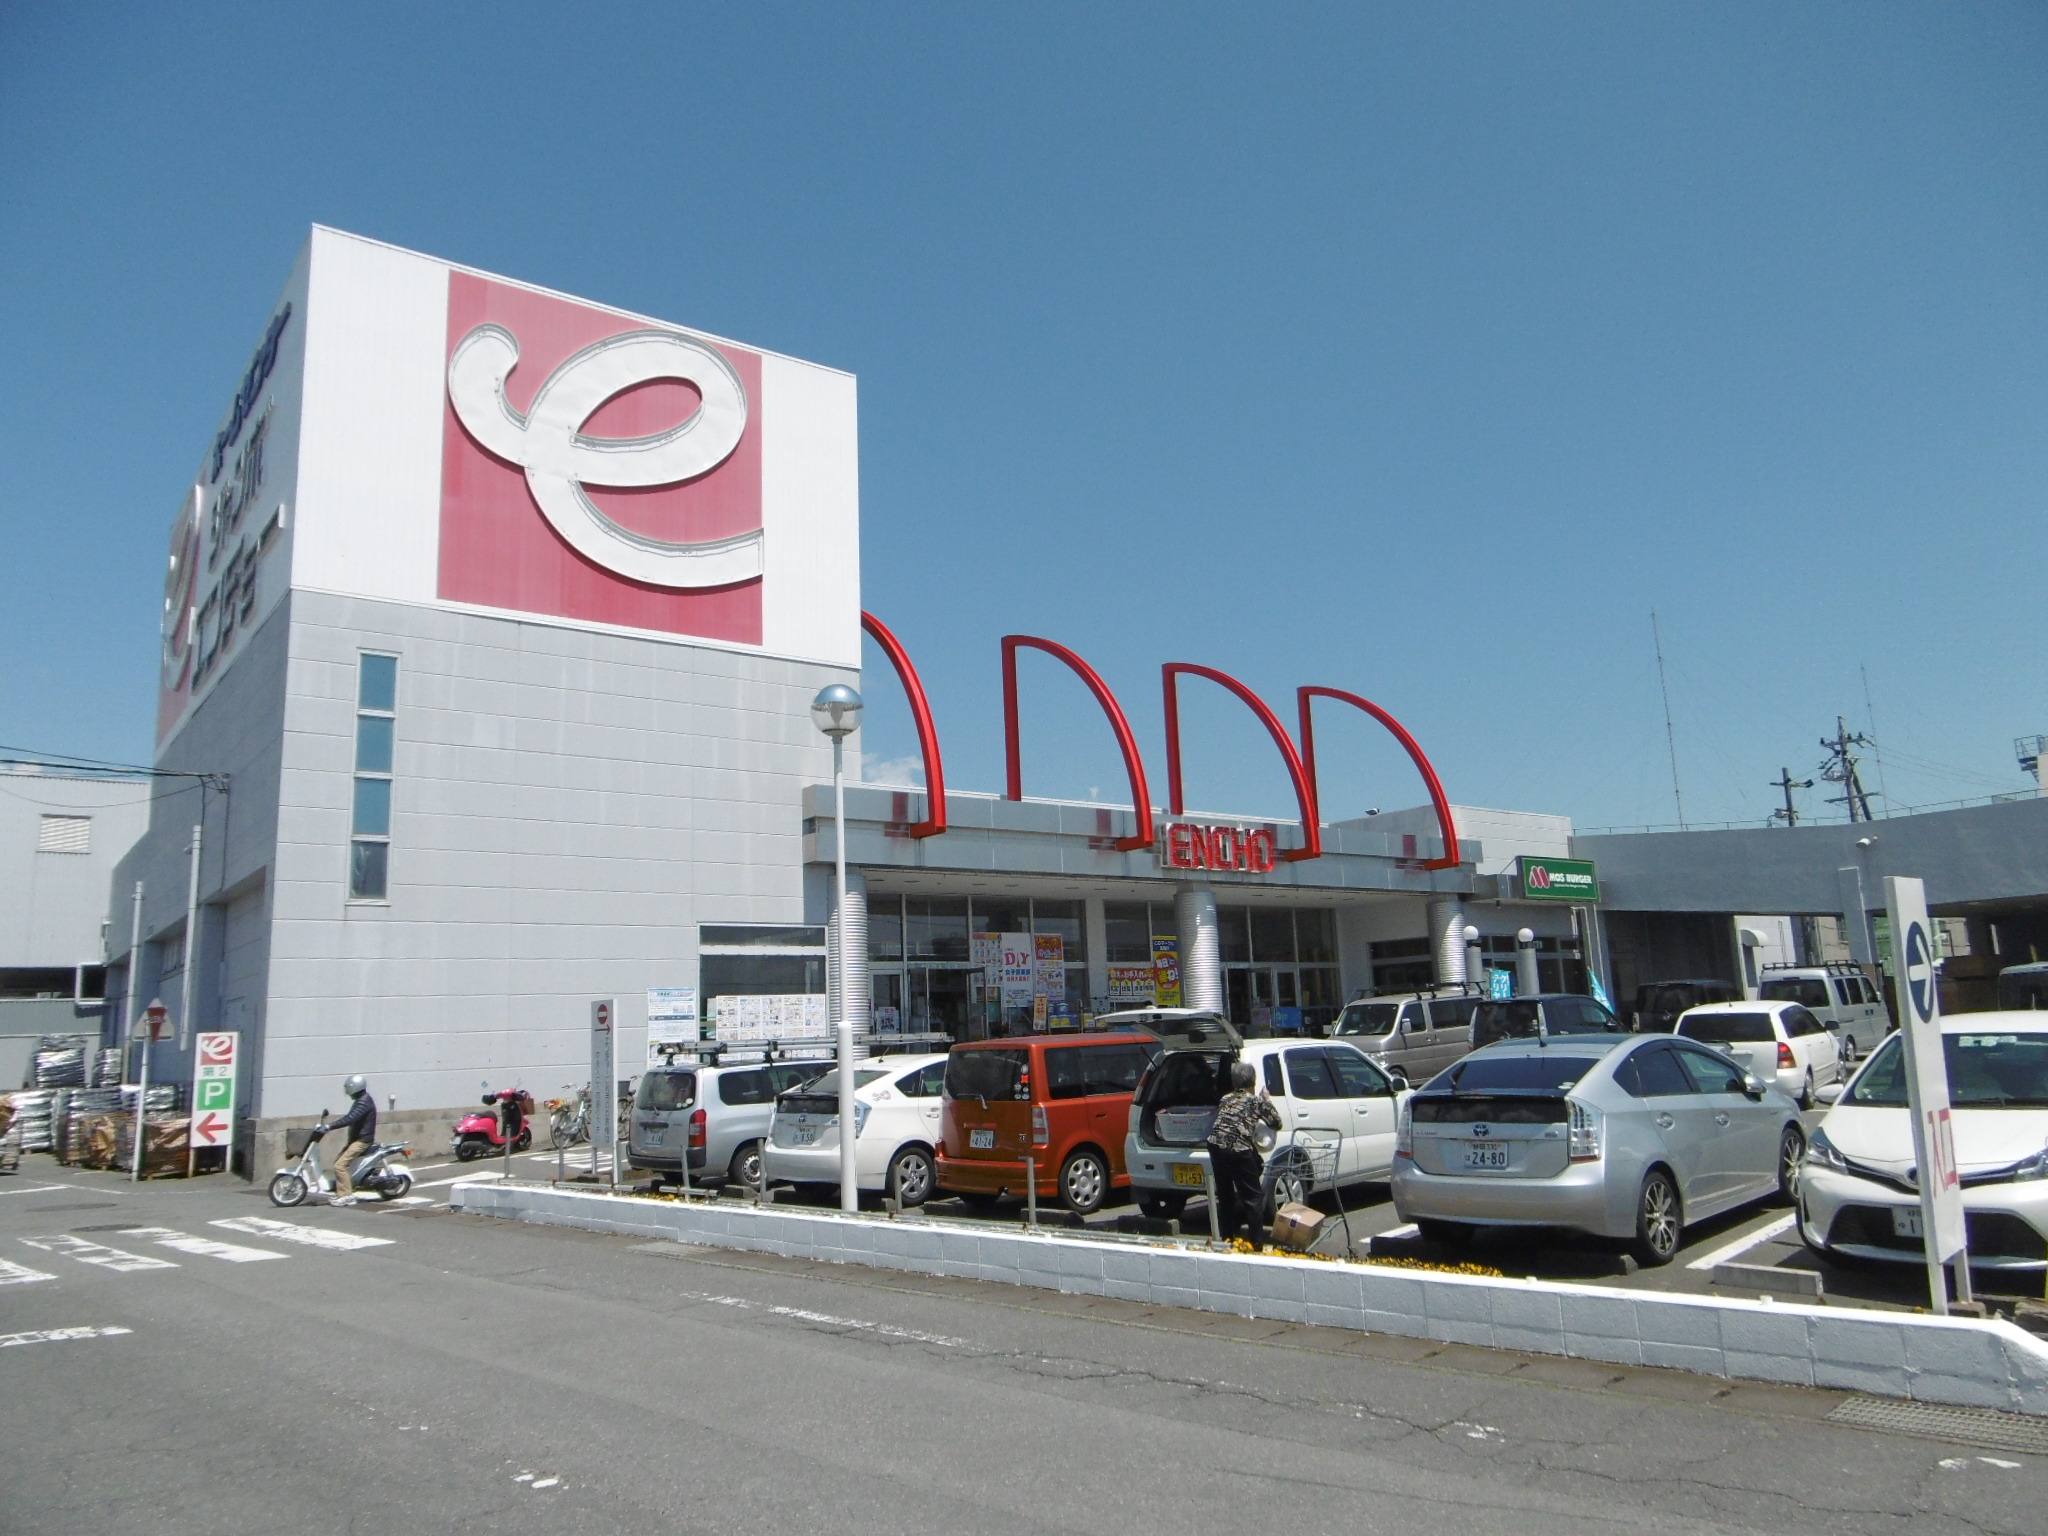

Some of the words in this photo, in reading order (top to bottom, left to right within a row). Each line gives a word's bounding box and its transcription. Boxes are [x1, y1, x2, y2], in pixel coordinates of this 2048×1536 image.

[1162, 822, 1275, 872] ENCHO
[1548, 872, 1565, 883] MOS
[1565, 873, 1593, 885] BURGER
[205, 1082, 225, 1106] P
[1472, 1152, 1505, 1165] 24-80
